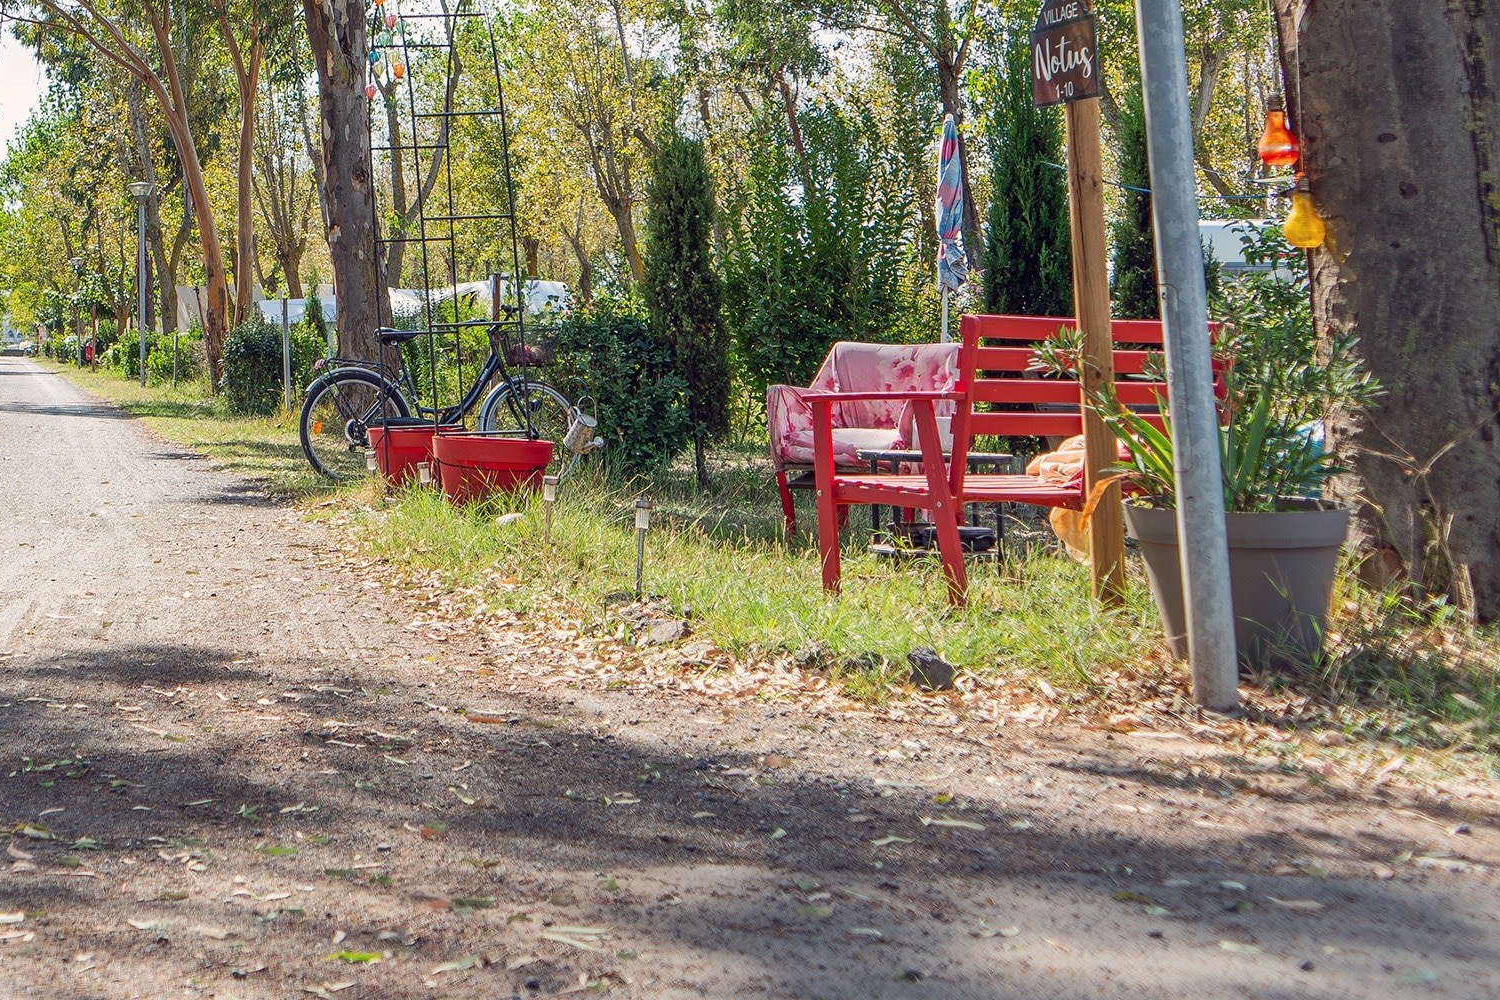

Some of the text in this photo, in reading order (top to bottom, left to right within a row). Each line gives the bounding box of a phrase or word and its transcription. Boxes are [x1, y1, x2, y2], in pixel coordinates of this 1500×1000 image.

[1043, 2, 1078, 25] VILLAGE
[1035, 36, 1095, 82] Notus
[1055, 81, 1074, 99] 1-10
